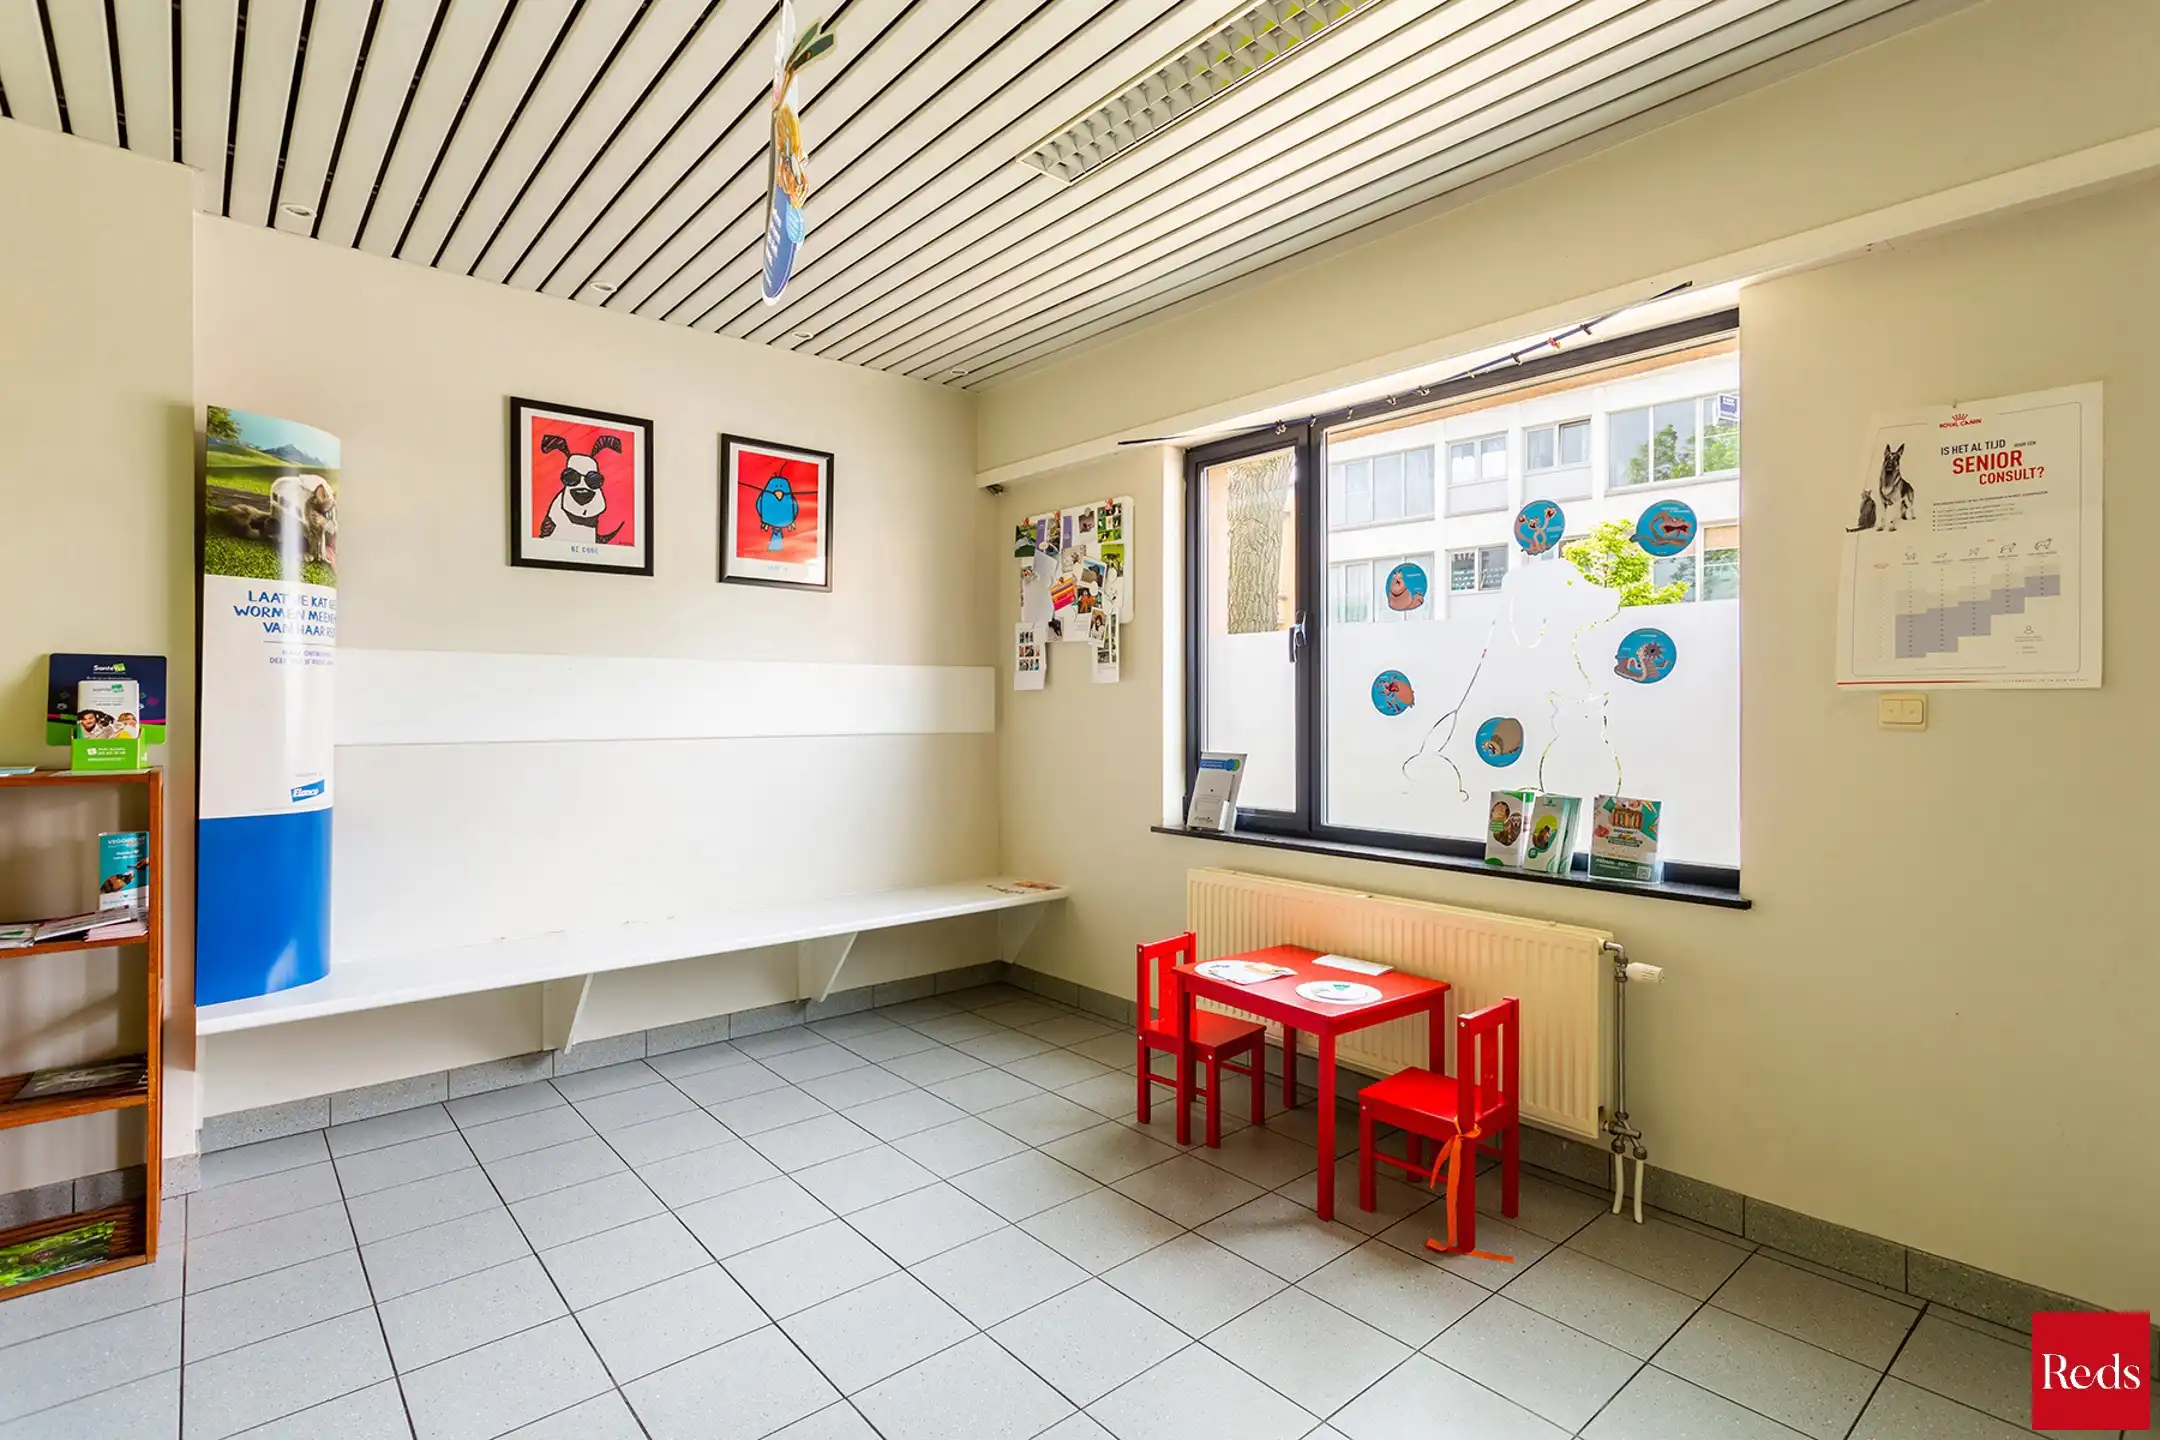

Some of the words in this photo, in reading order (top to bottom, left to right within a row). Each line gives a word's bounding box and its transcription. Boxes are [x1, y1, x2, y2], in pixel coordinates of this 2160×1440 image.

[1941, 446, 1950, 455] IS
[1951, 444, 1969, 454] HET
[1971, 442, 1982, 452] AL
[1985, 439, 2006, 450] TIJD
[1952, 450, 2023, 475] SENIOR
[1979, 466, 2045, 485] CONSULT?
[248, 590, 289, 604] LAAT
[311, 595, 328, 608] KAT
[233, 605, 305, 621] WORMEN
[262, 621, 293, 634] VAN
